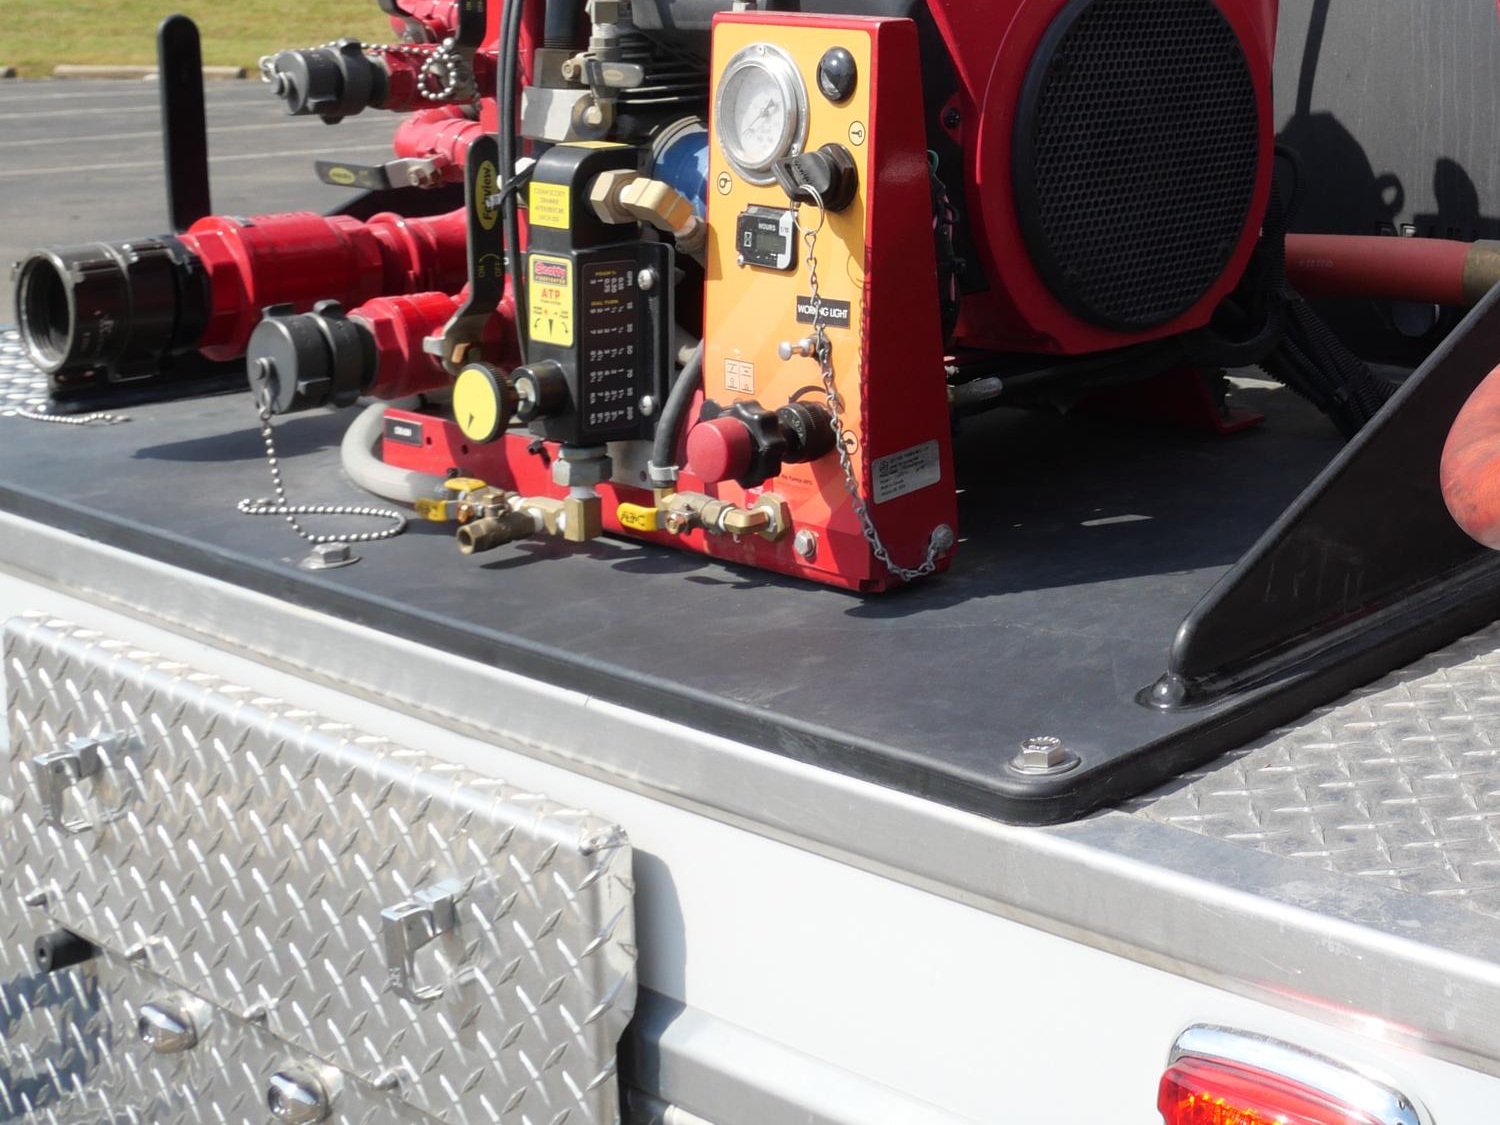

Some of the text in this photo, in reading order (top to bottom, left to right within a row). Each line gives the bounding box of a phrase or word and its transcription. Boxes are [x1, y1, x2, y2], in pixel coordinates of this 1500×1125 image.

[758, 223, 776, 232] HOURS
[541, 288, 561, 300] ATP
[798, 304, 848, 319] WORKNG LIGHT
